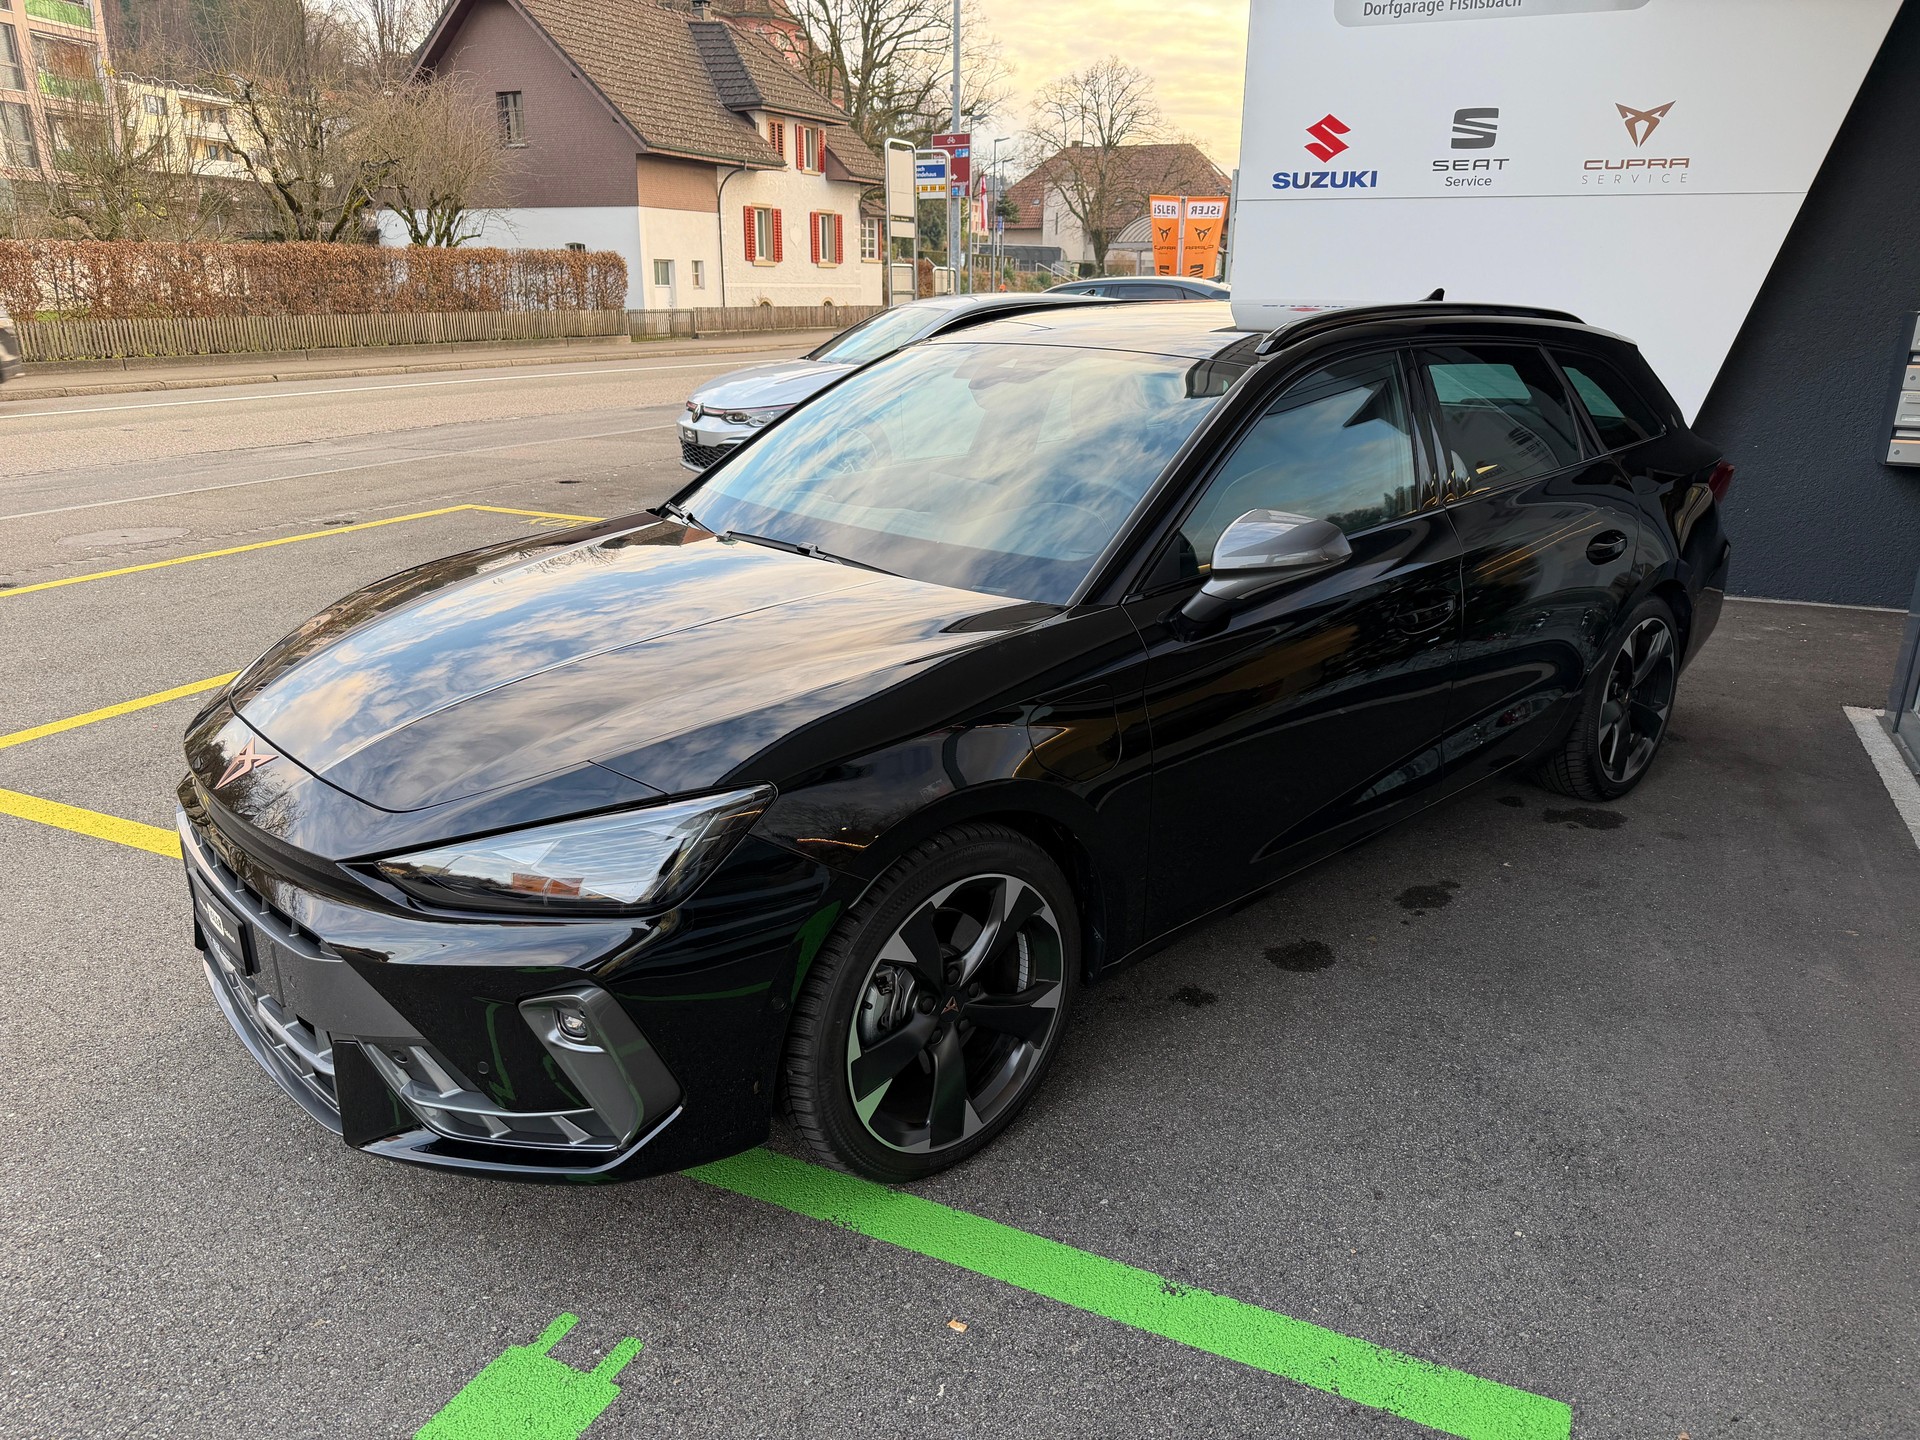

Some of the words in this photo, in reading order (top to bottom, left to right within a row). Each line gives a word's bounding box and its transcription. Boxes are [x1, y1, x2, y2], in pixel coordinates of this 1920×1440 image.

[1363, 0, 1444, 18] Dorfgarage
[1432, 158, 1510, 171] SEAT
[1583, 157, 1690, 170] CUPRA
[1272, 170, 1378, 189] SUZUKI
[1444, 175, 1492, 187] Service
[1581, 173, 1688, 184] SERVICE
